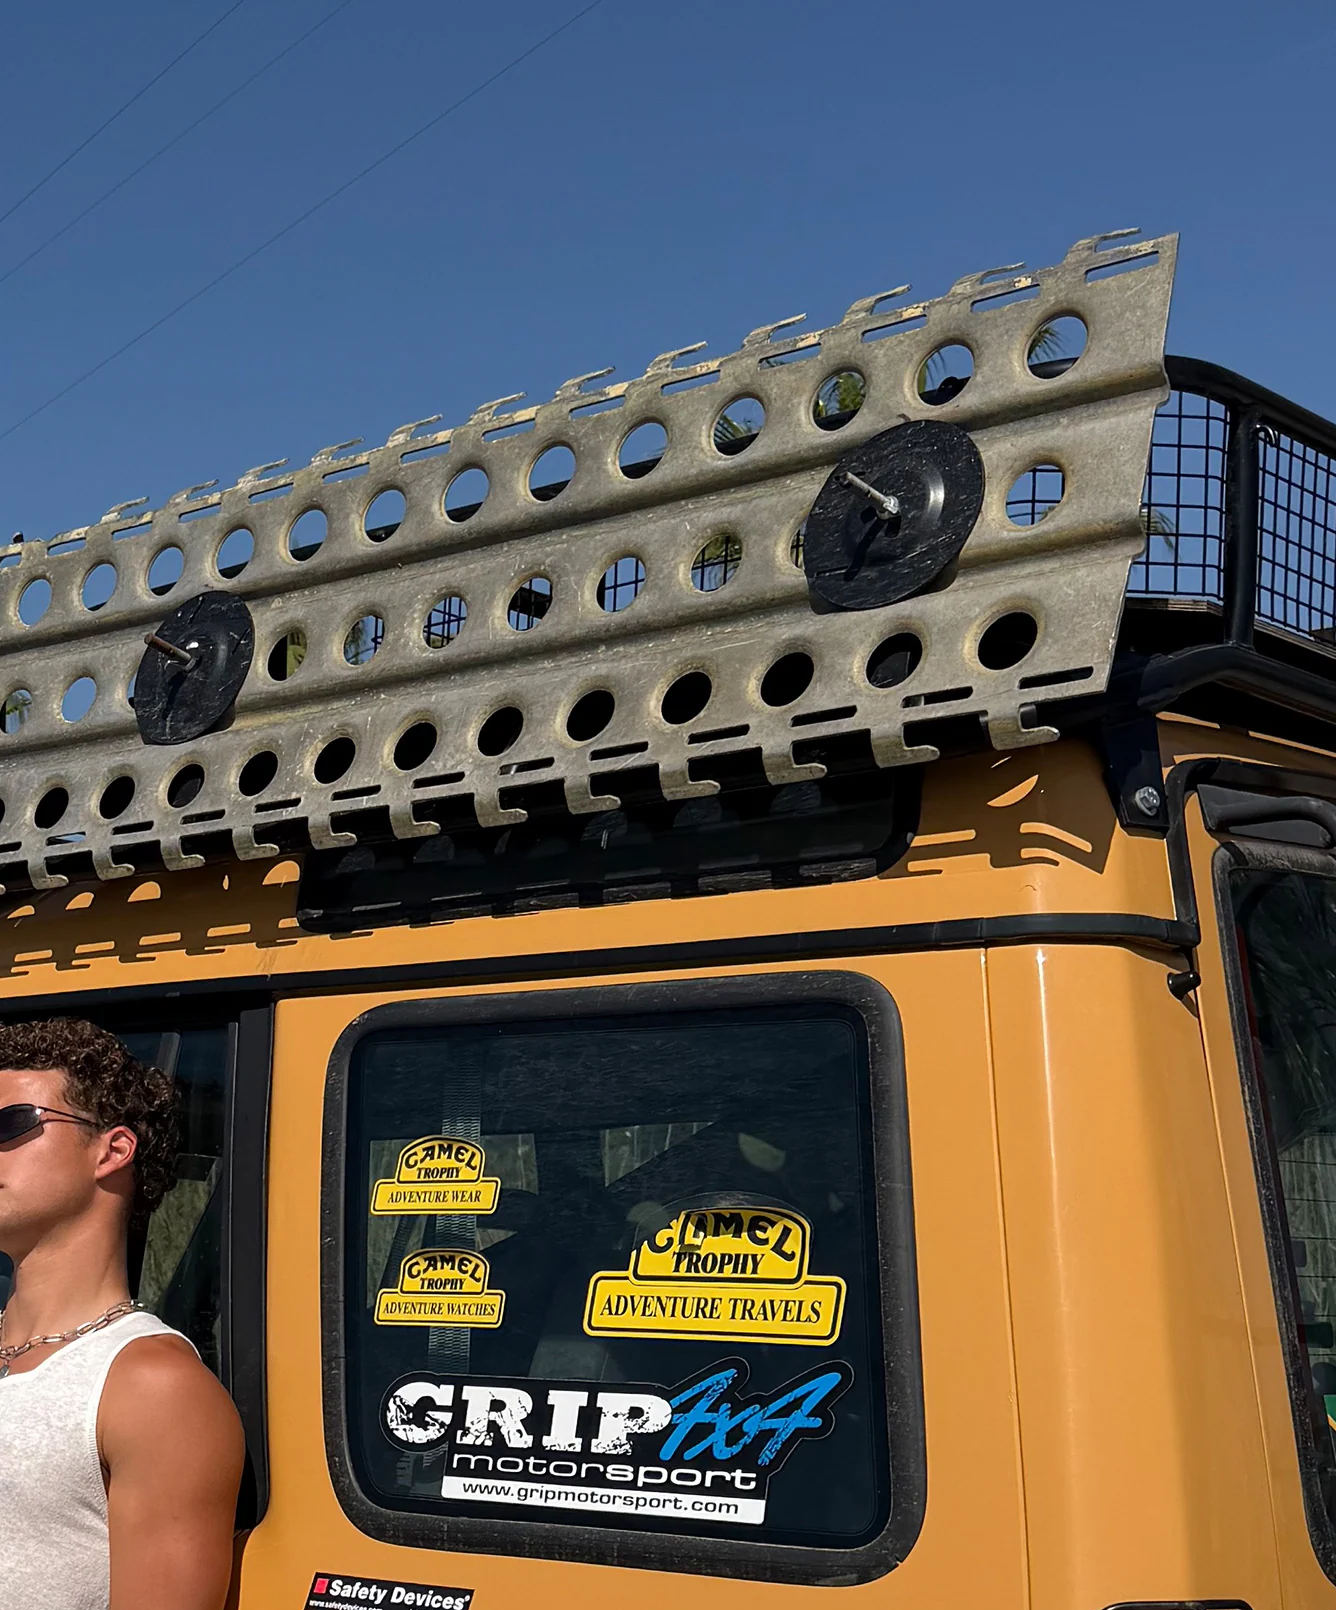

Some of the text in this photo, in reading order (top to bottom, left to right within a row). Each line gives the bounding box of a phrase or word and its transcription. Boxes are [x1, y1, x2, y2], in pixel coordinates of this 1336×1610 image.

[404, 1143, 478, 1171] CAMEL
[416, 1166, 463, 1179] TROPHY
[387, 1190, 482, 1204] ADVENTURE WEAR
[407, 1254, 482, 1283] CAMEL
[672, 1251, 765, 1275] TROPHY
[419, 1277, 466, 1291] TROPHY
[383, 1302, 496, 1317] ADVENTURE WATCHES
[600, 1294, 822, 1324] ADVENTURE TRAVELS
[386, 1381, 673, 1456] GRIP
[452, 1452, 757, 1491] motorsport
[462, 1482, 739, 1515] www.gripmotorsport.com
[329, 1579, 388, 1605] Safety
